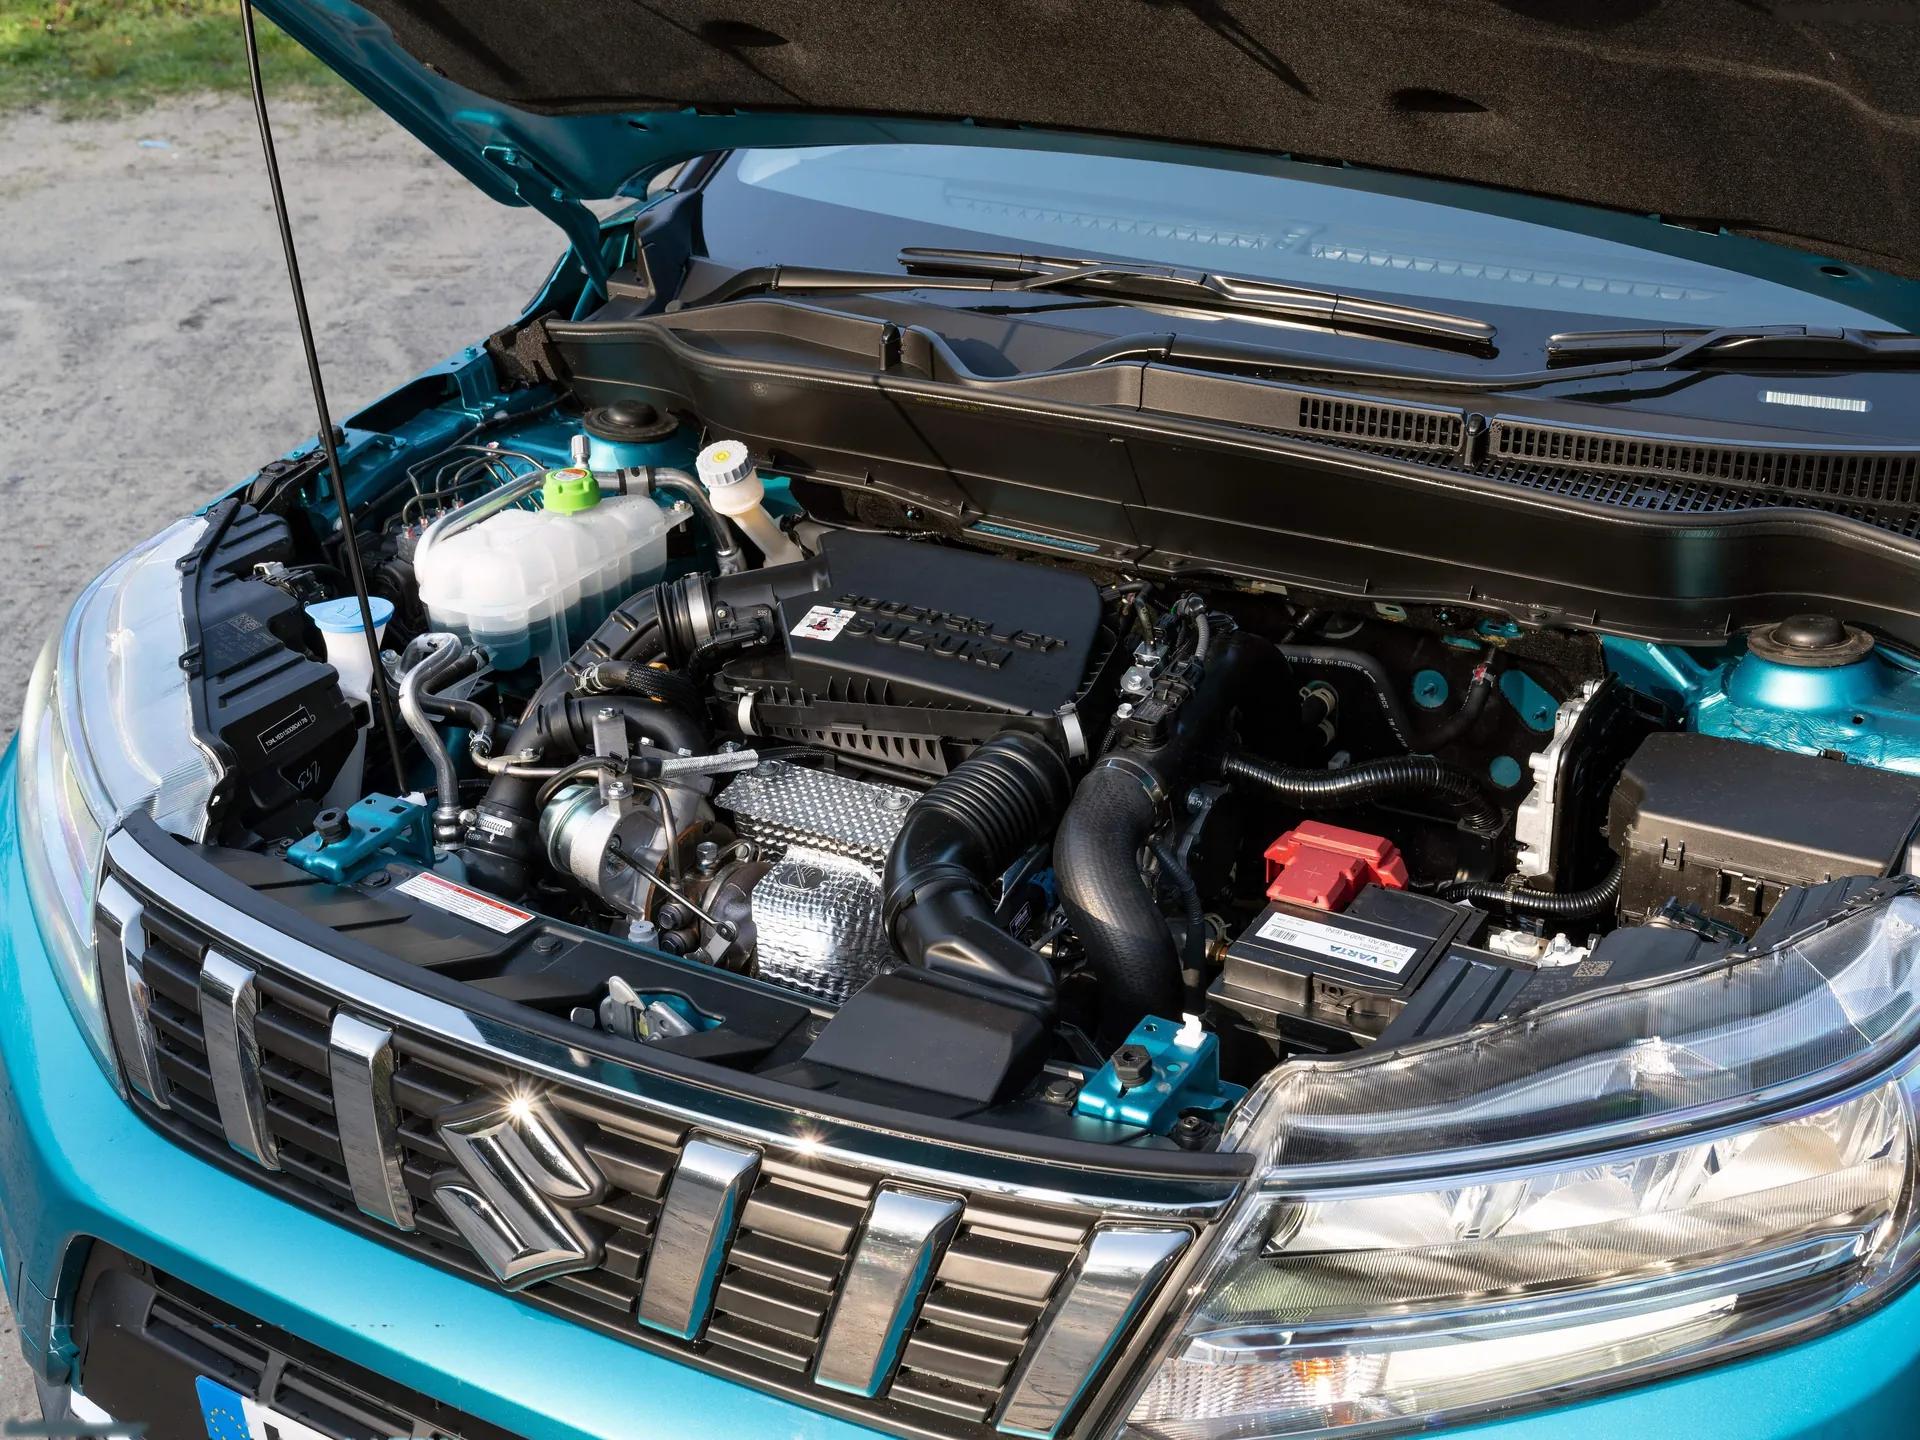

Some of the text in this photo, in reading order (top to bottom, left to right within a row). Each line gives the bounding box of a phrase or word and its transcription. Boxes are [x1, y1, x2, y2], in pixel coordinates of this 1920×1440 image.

[843, 617, 1013, 669] SUZUKI
[1349, 933, 1365, 941] 300
[1329, 944, 1378, 963] VARTA
